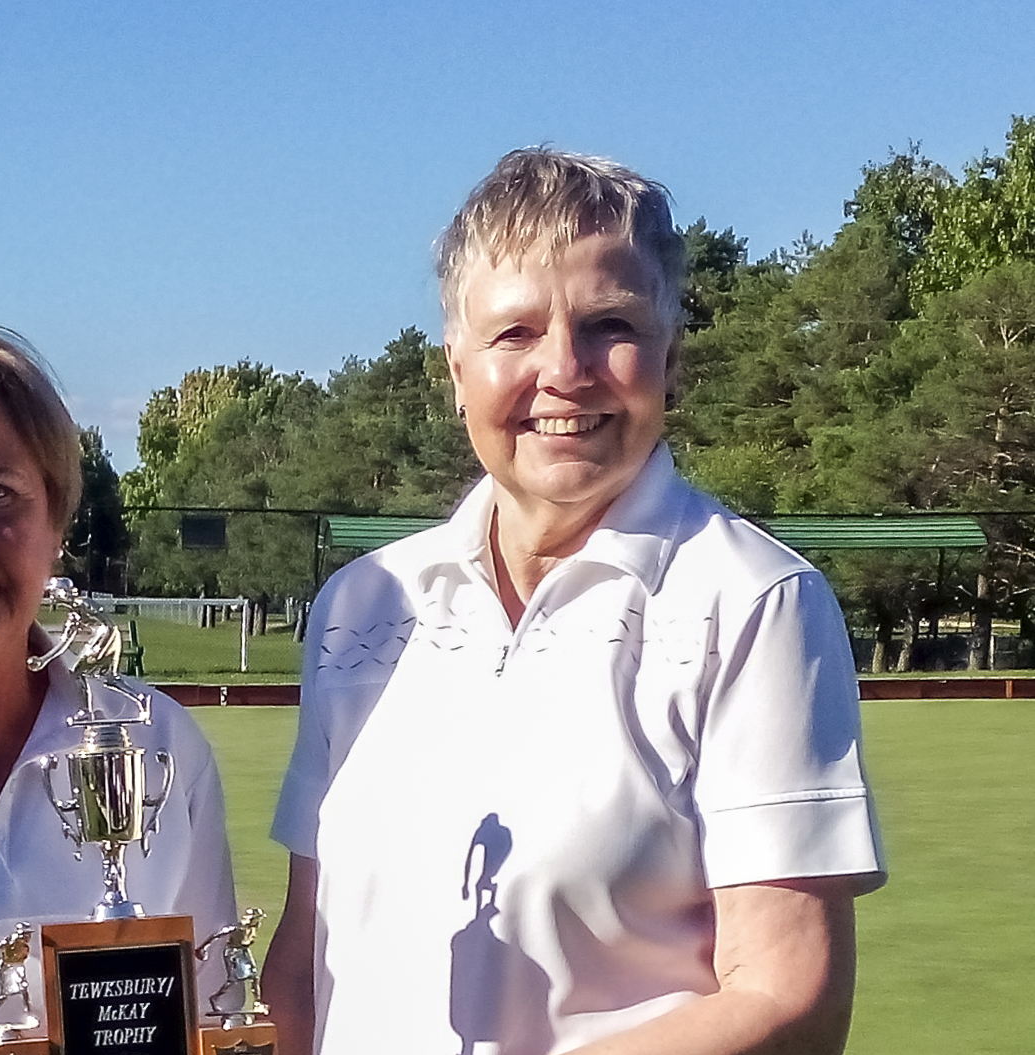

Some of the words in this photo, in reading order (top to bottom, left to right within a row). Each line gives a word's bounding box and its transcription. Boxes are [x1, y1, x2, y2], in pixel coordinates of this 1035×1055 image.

[70, 976, 175, 1000] TEWKSBURY/
[97, 1002, 151, 1022] McKAY
[93, 1026, 157, 1047] TROPHY
